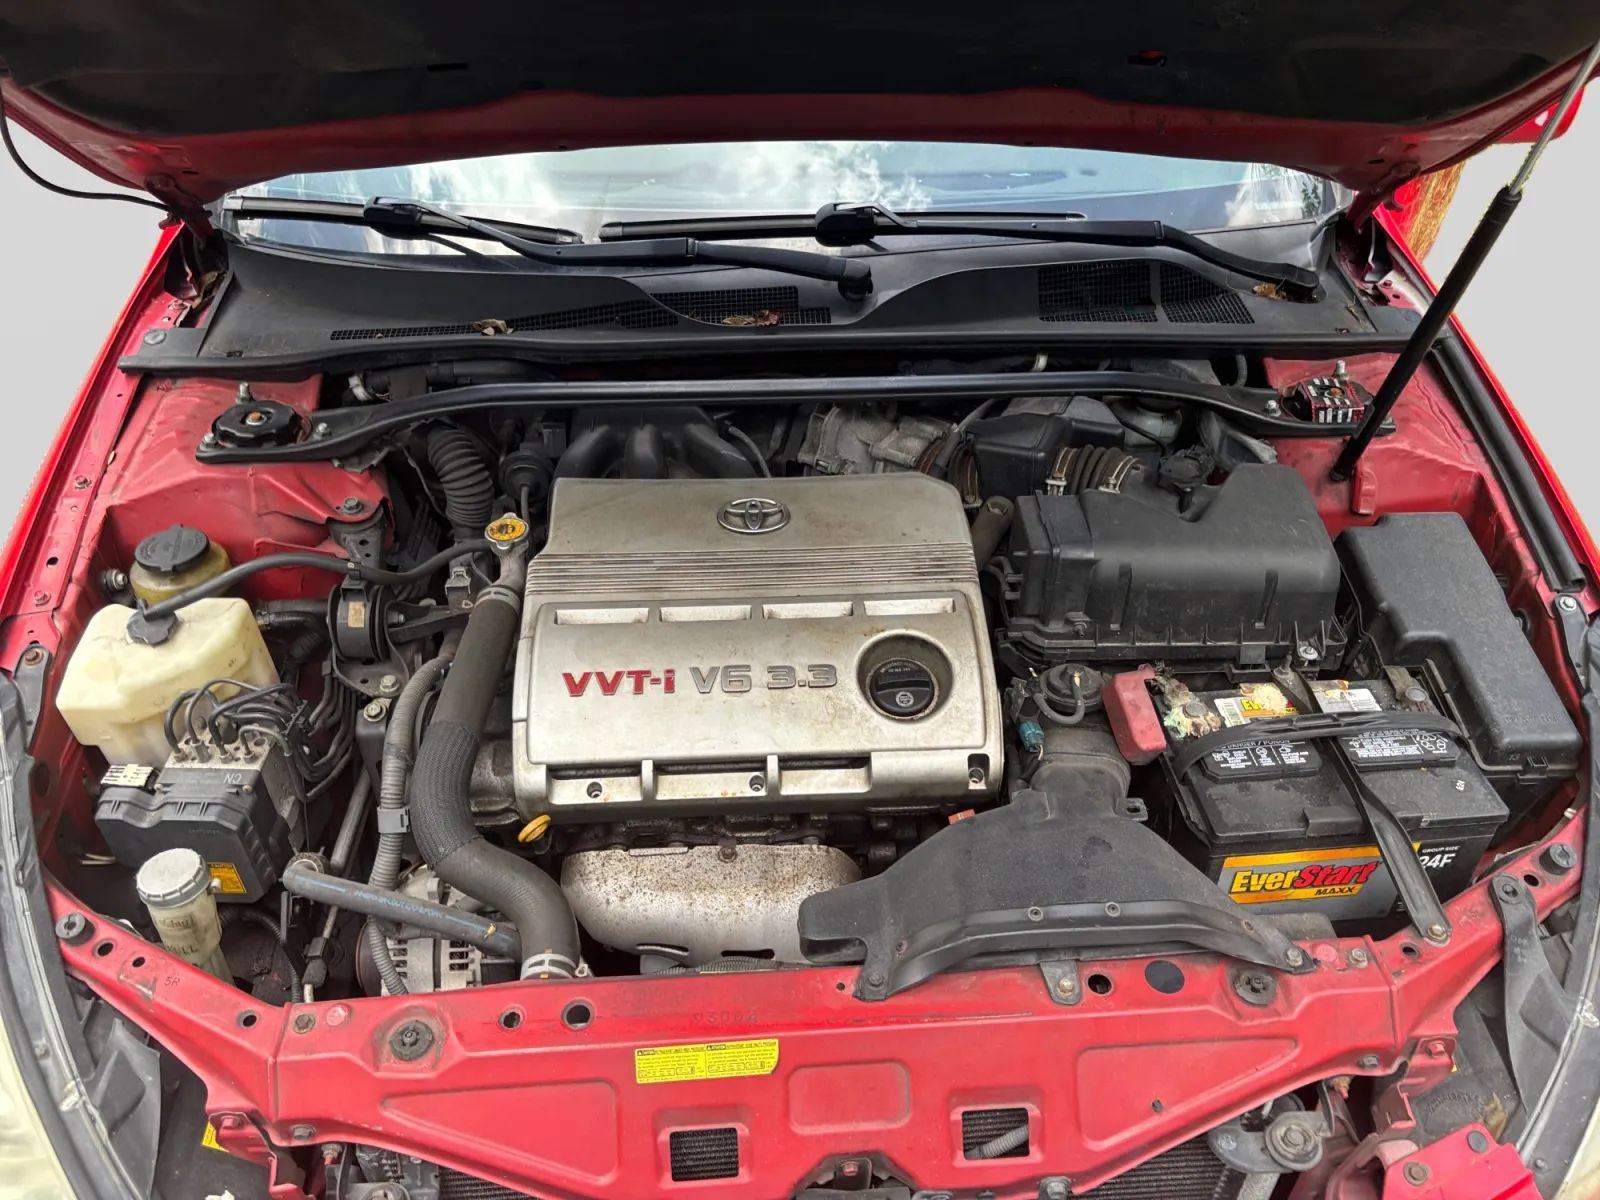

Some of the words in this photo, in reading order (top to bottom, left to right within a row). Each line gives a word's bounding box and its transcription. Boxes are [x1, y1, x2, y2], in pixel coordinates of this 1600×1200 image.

[561, 668, 676, 697] VVT-i
[689, 664, 752, 694] V6
[766, 664, 838, 690] 3.3
[1230, 861, 1378, 893] EverStart
[1314, 886, 1356, 896] MAXX
